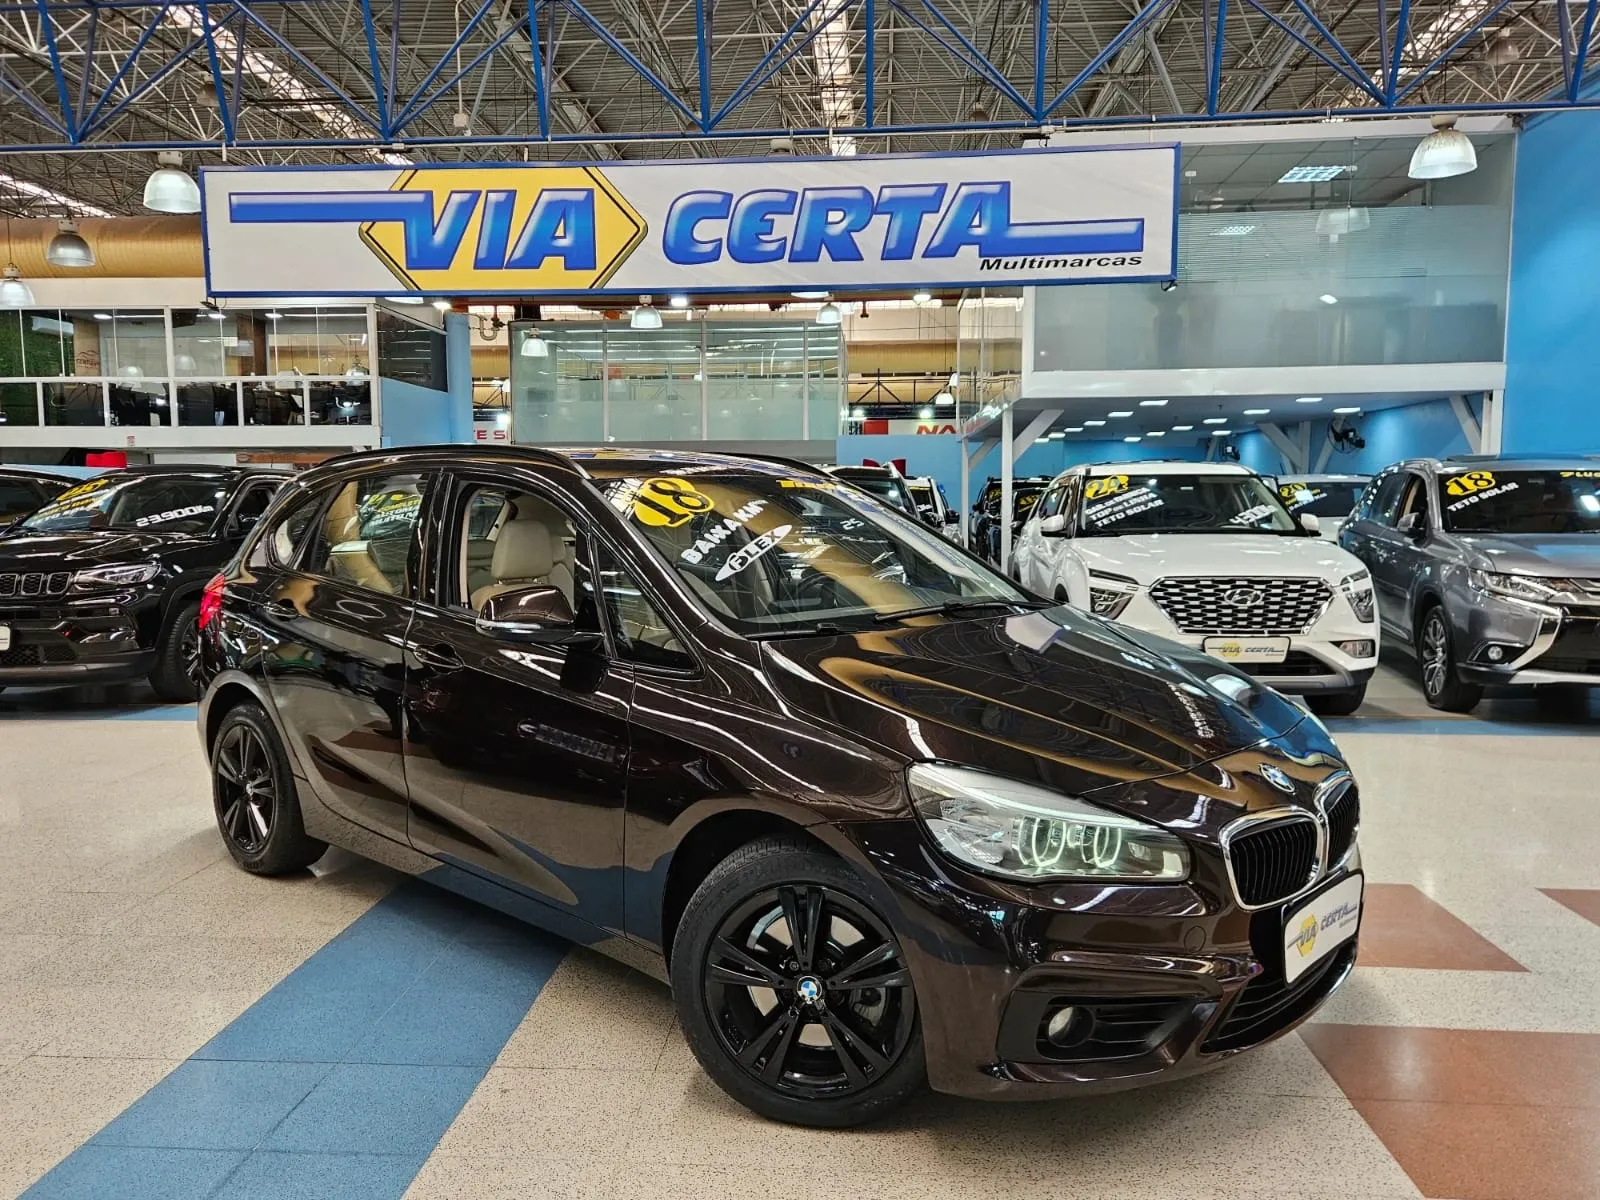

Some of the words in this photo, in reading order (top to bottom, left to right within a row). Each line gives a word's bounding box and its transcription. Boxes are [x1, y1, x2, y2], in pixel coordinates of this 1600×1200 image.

[401, 189, 597, 271] VIA
[663, 182, 1011, 265] CERTA
[980, 255, 1142, 271] Multimarcas
[1447, 496, 1479, 512] TETO
[1478, 482, 1519, 500] SOLAR
[1448, 472, 1493, 494] 18
[631, 479, 708, 525] 18
[1089, 508, 1113, 520] TOP
[1122, 493, 1158, 508] LINHA
[1094, 511, 1127, 528] TETO
[1125, 499, 1164, 517] SOLAR
[681, 518, 742, 564] BAIXA
[728, 530, 783, 571] FLEX
[1300, 925, 1317, 947] VIA
[1320, 903, 1348, 931] CERTA
